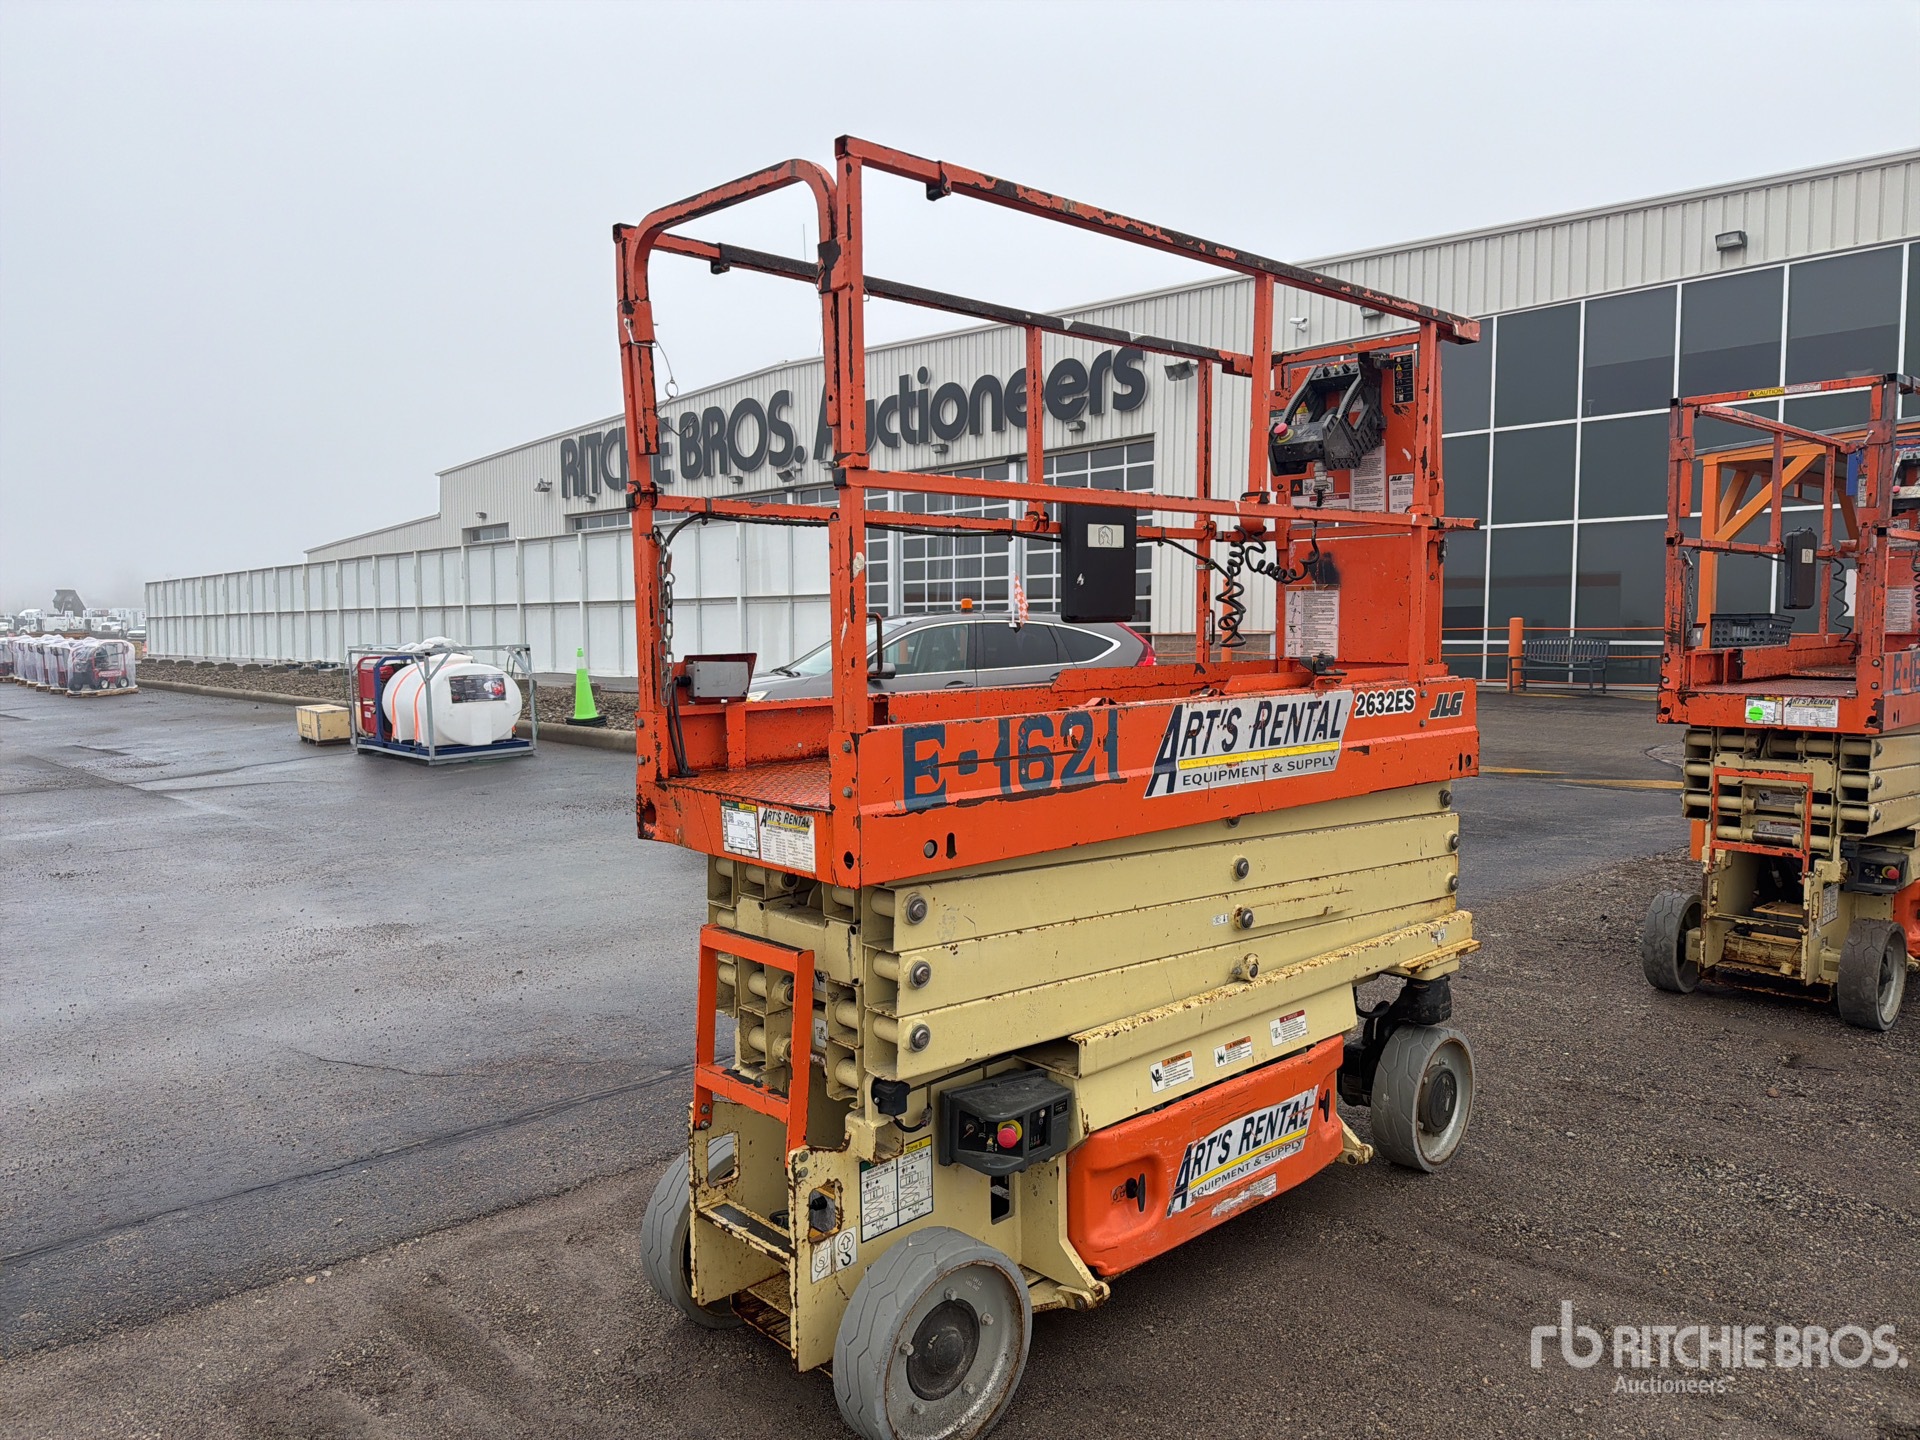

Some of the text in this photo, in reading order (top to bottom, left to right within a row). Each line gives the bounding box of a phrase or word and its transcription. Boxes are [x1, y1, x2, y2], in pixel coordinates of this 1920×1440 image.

[1755, 387, 1783, 397] CAUTION
[560, 417, 673, 498] RITCE
[679, 389, 807, 480] BROS.
[1355, 688, 1416, 717] 2632ES
[1429, 691, 1465, 719] JLG
[902, 709, 1120, 812] E-1621
[1144, 699, 1342, 797] ART'S RENTAL
[1183, 755, 1336, 786] EQUIPMENT & SUPPLY
[760, 808, 782, 828] ART'S
[783, 812, 811, 828] RENTAL
[1166, 1129, 1233, 1217] ART'S
[1238, 1096, 1309, 1155] RENTAL
[1191, 1162, 1251, 1199] EQUIPMENT
[1253, 1157, 1262, 1167] &
[1264, 1140, 1303, 1162] SUPPLY
